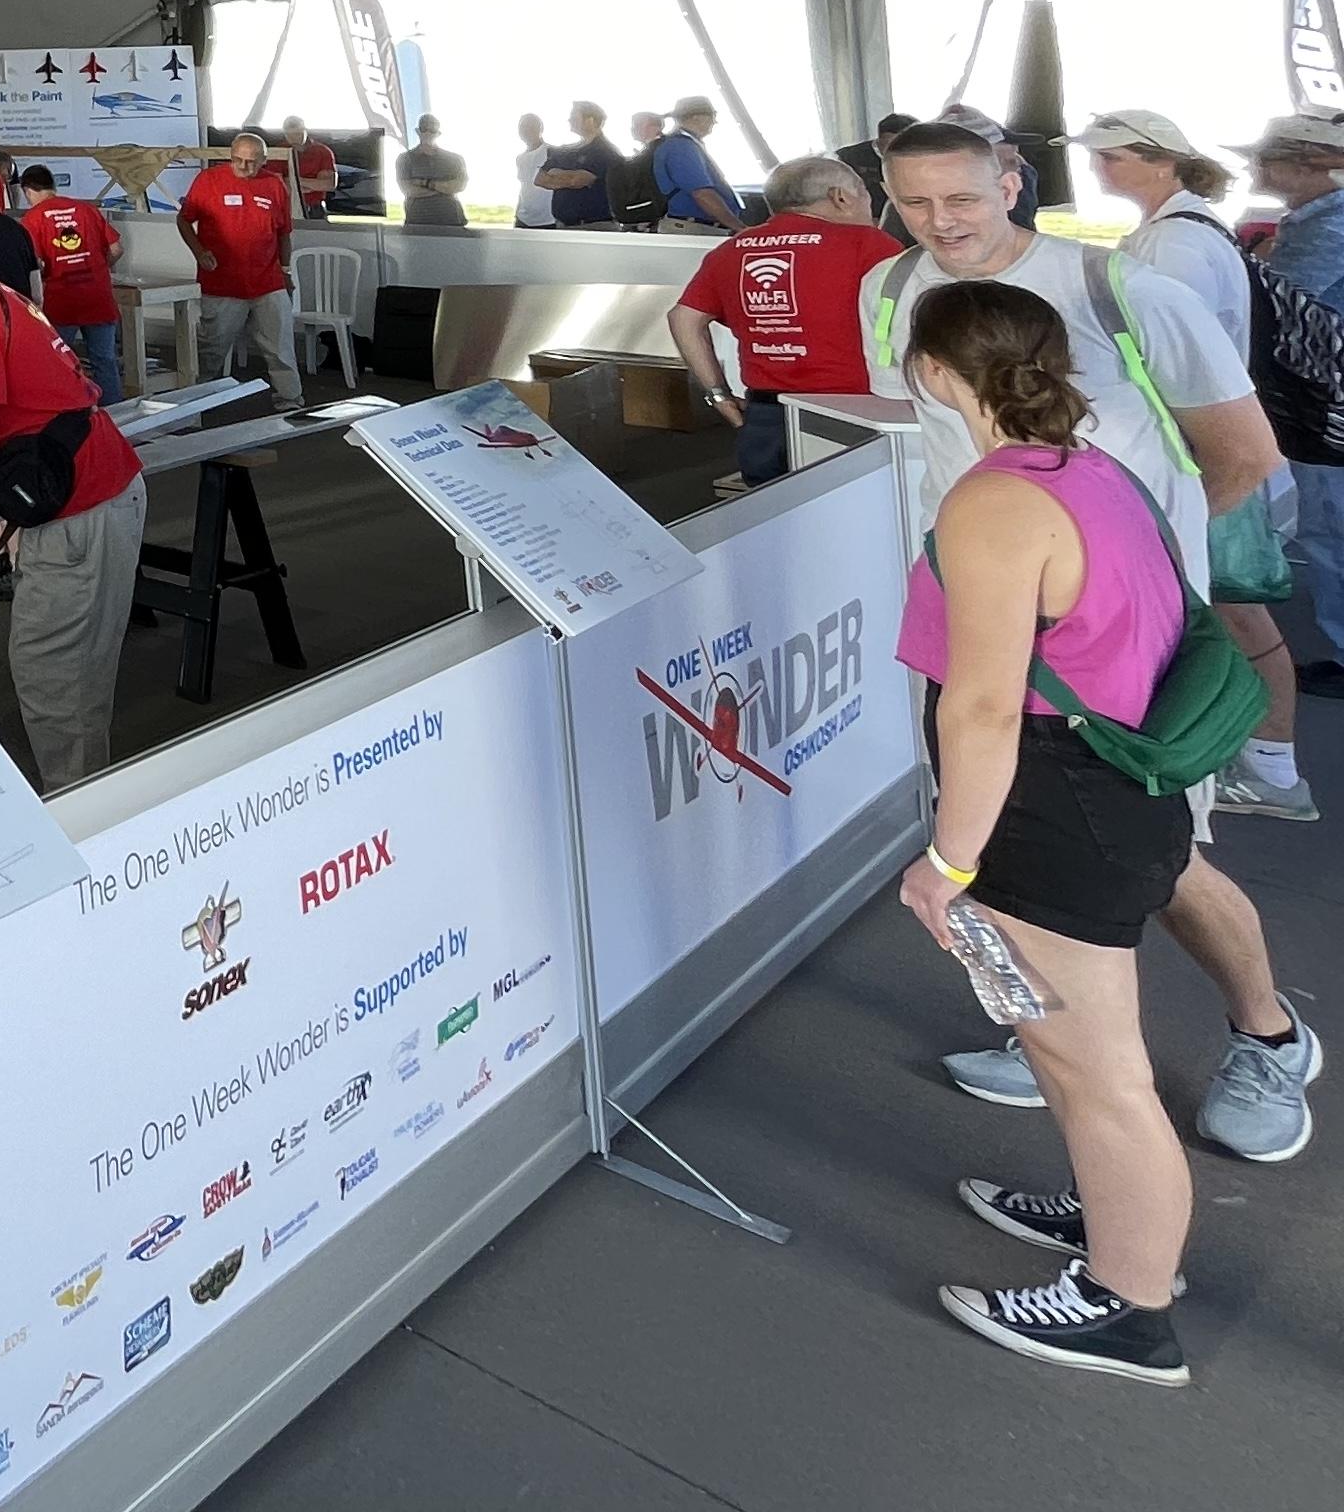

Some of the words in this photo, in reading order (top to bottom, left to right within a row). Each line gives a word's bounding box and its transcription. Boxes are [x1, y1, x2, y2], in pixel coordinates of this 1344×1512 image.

[11, 93, 28, 103] the
[32, 91, 63, 101] Paint
[736, 234, 822, 248] VOLUNTEER
[746, 291, 787, 303] Wi-Fi
[666, 648, 701, 688] ONE
[713, 622, 753, 666] WEEK
[643, 598, 862, 822] WONDER
[784, 713, 838, 776] OSHKOSH
[74, 874, 116, 915] The
[124, 847, 170, 890] One
[174, 810, 235, 864] Week
[237, 775, 309, 832] Wonder
[315, 765, 330, 793] is
[333, 715, 420, 785] Presented
[423, 710, 443, 741] by
[299, 829, 393, 915] ROTAX
[182, 957, 251, 1021] sonex
[494, 969, 519, 1001] MGL
[90, 1152, 133, 1192] The
[141, 1118, 187, 1161] One
[192, 1065, 252, 1127] Week
[256, 1018, 329, 1084] Wonder
[335, 1003, 349, 1035] is
[353, 934, 444, 1021] Supported
[449, 927, 468, 957] by
[324, 1070, 372, 1121] earthX
[203, 1168, 238, 1209] CROW
[126, 1302, 169, 1344] SCHEME
